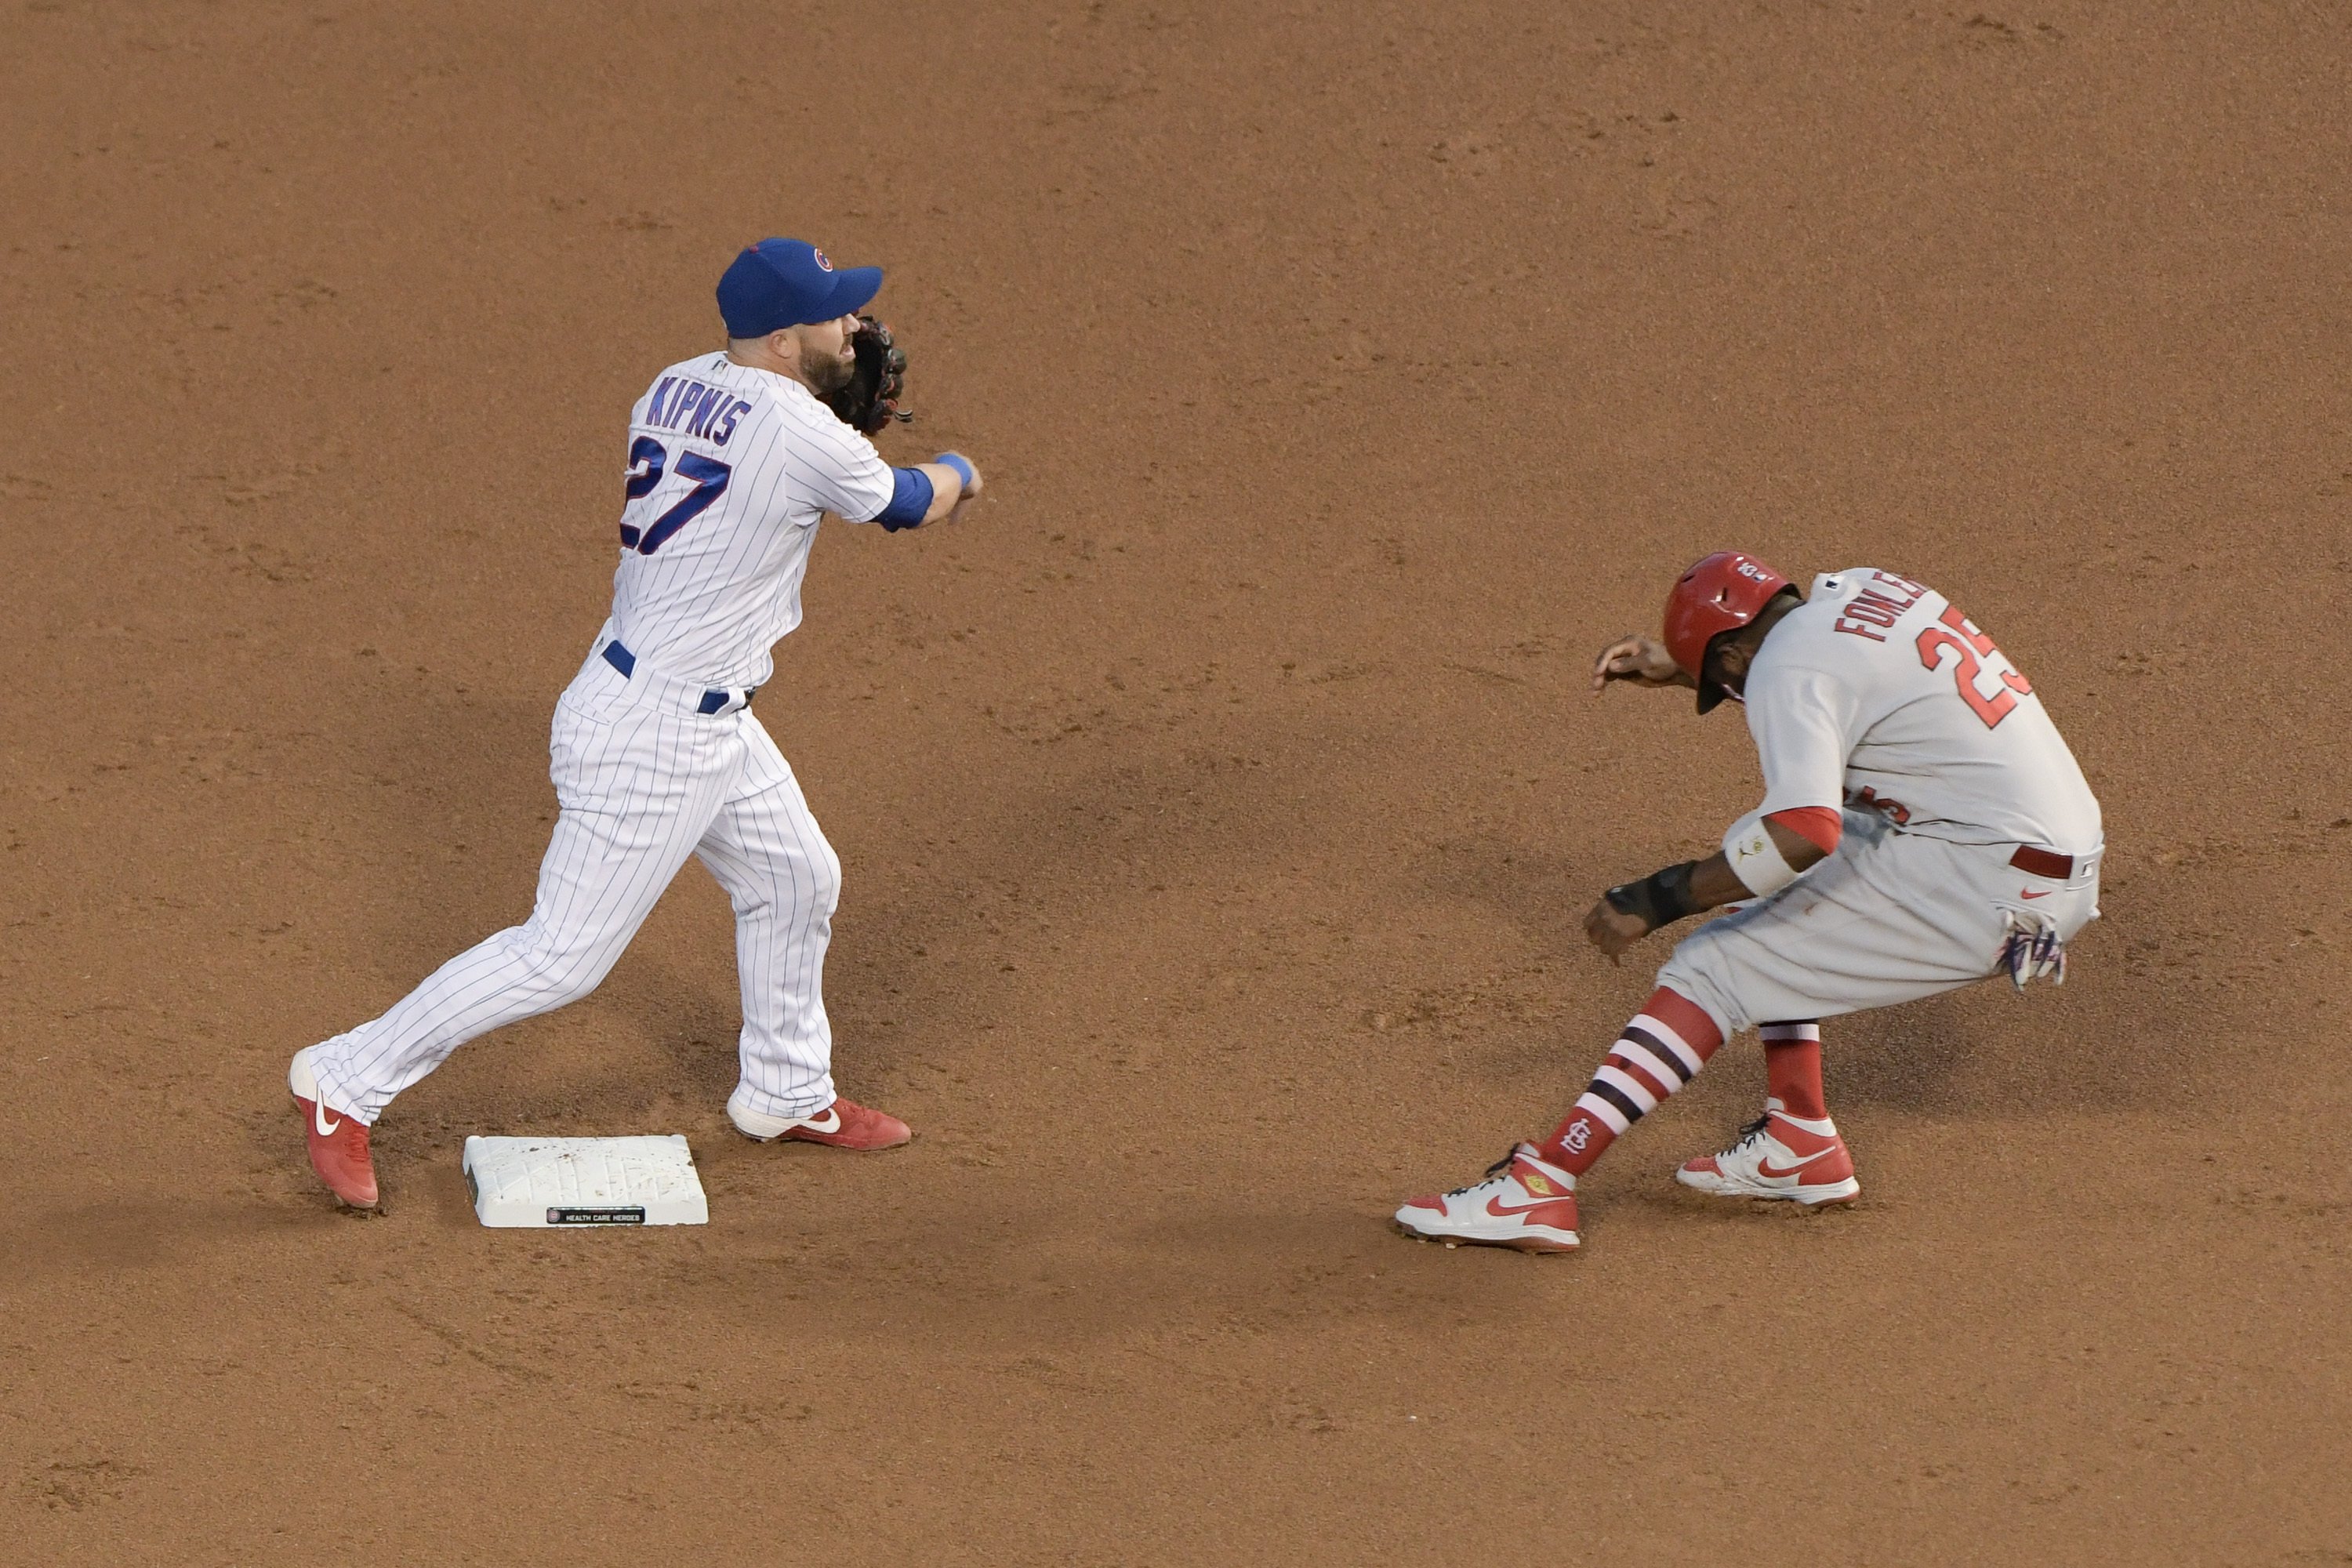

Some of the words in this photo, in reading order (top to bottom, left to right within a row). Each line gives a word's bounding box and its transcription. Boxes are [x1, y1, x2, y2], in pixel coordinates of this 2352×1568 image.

[646, 376, 752, 446] KIPNIS
[619, 435, 732, 555] 27
[1834, 571, 1928, 643] FOWLE
